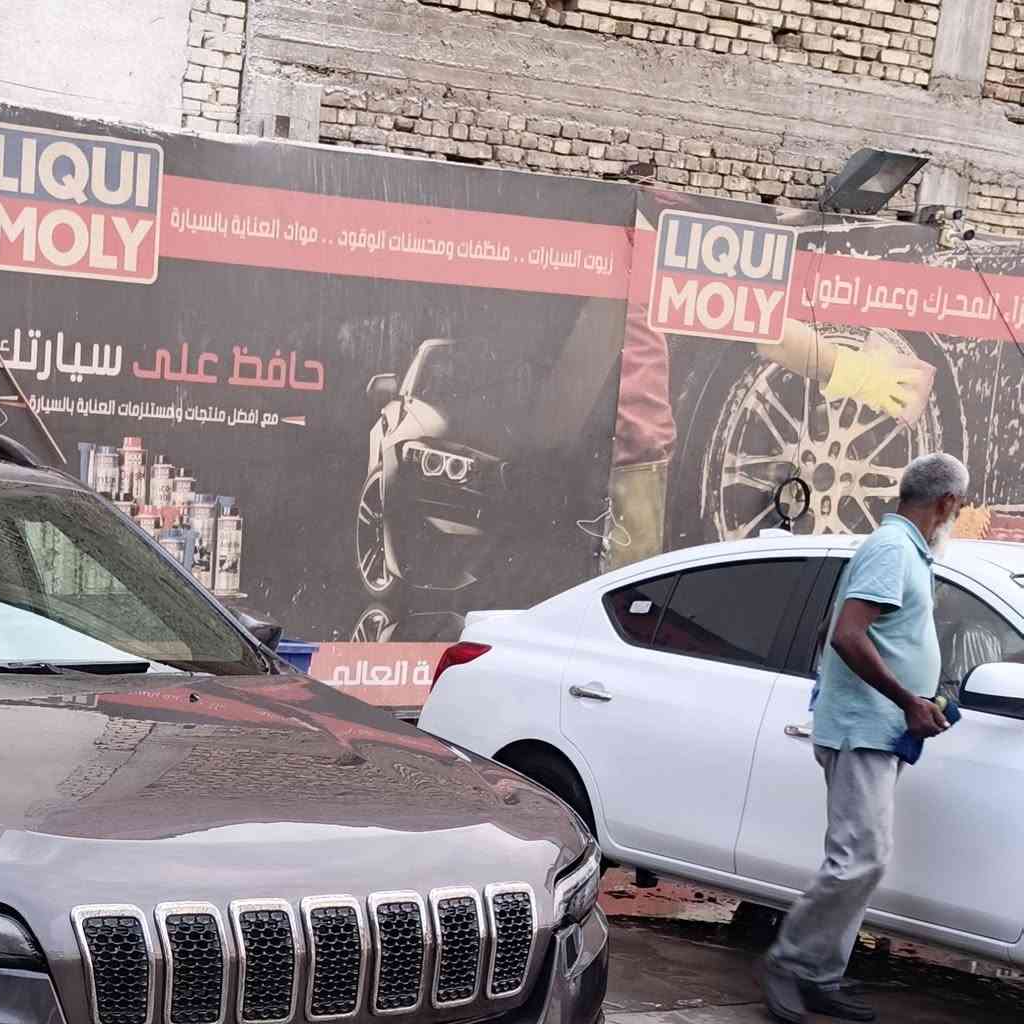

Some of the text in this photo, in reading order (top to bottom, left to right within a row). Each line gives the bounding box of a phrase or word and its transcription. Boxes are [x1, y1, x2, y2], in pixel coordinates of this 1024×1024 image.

[170, 207, 228, 237] بالسيارة
[231, 215, 280, 240] العناية
[284, 222, 318, 246] مواد
[337, 228, 385, 253] الوقود
[389, 231, 454, 260] ومحسنات
[457, 239, 510, 262] منظفات
[664, 219, 788, 281] LIQUI
[528, 246, 581, 270] السيارات
[583, 253, 615, 275] زيوت
[801, 272, 862, 309] اطول
[860, 284, 920, 318] وعمر
[923, 284, 1001, 321] المحرك
[657, 277, 785, 335] MOLY
[132, 342, 219, 384] على
[228, 345, 325, 391] حافظ
[29, 394, 75, 415] بالسيارة
[76, 397, 115, 418] العناية
[185, 406, 226, 425] منتجات
[261, 412, 279, 428] مع
